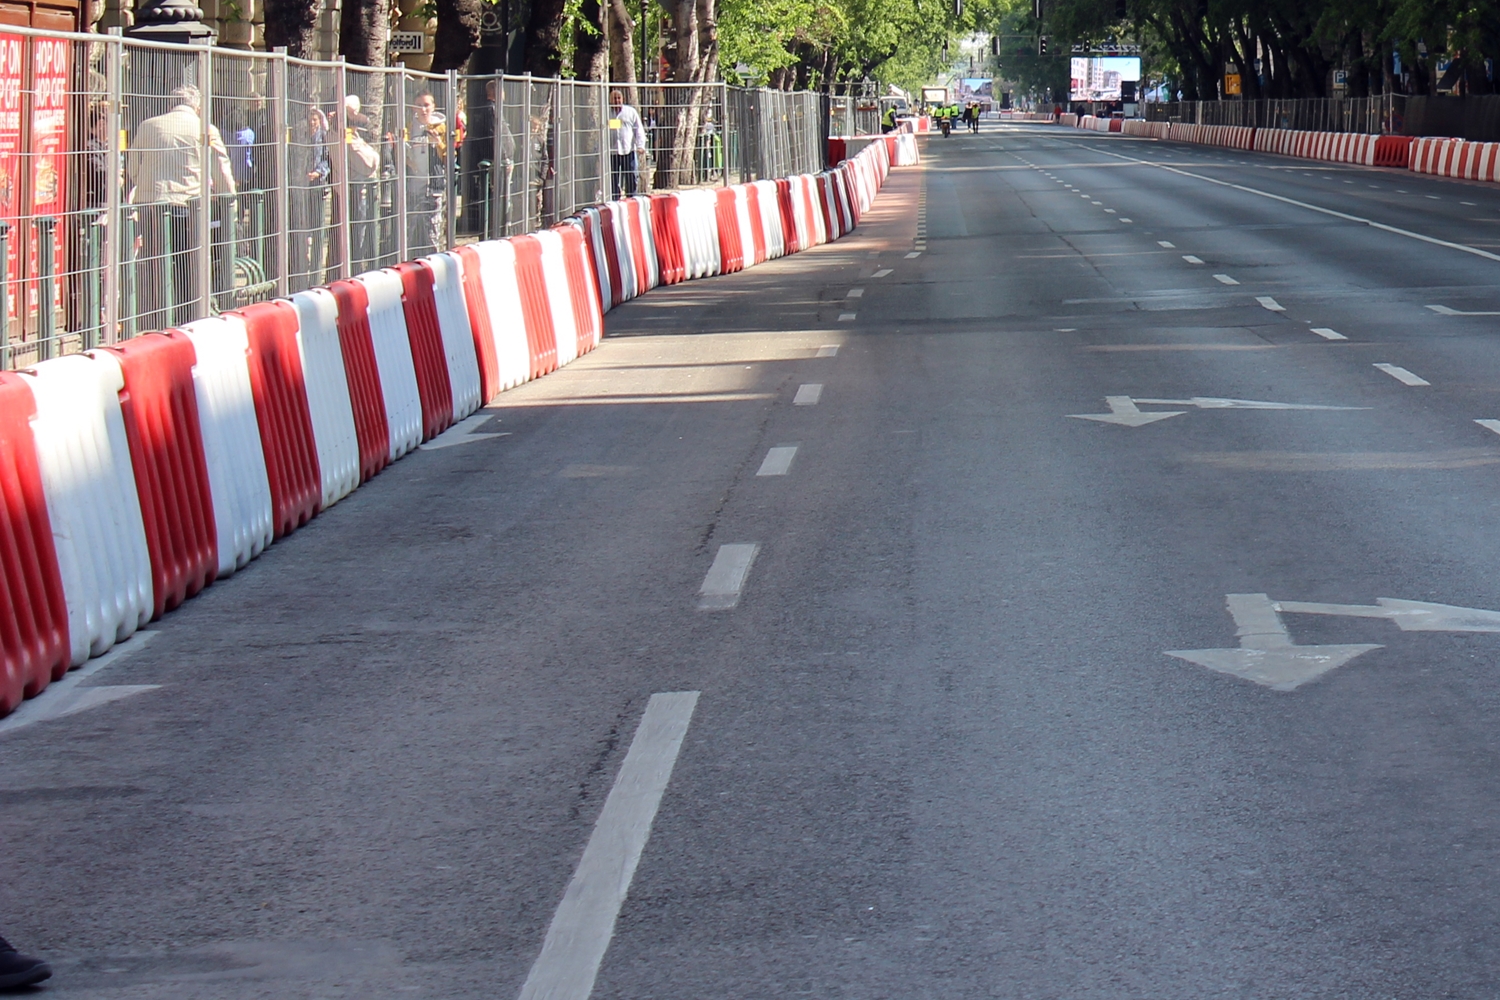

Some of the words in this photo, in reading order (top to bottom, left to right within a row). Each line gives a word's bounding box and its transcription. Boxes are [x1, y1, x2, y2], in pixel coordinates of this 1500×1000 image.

[8, 40, 21, 75] ON
[54, 41, 66, 74] ON
[1336, 73, 1344, 83] P
